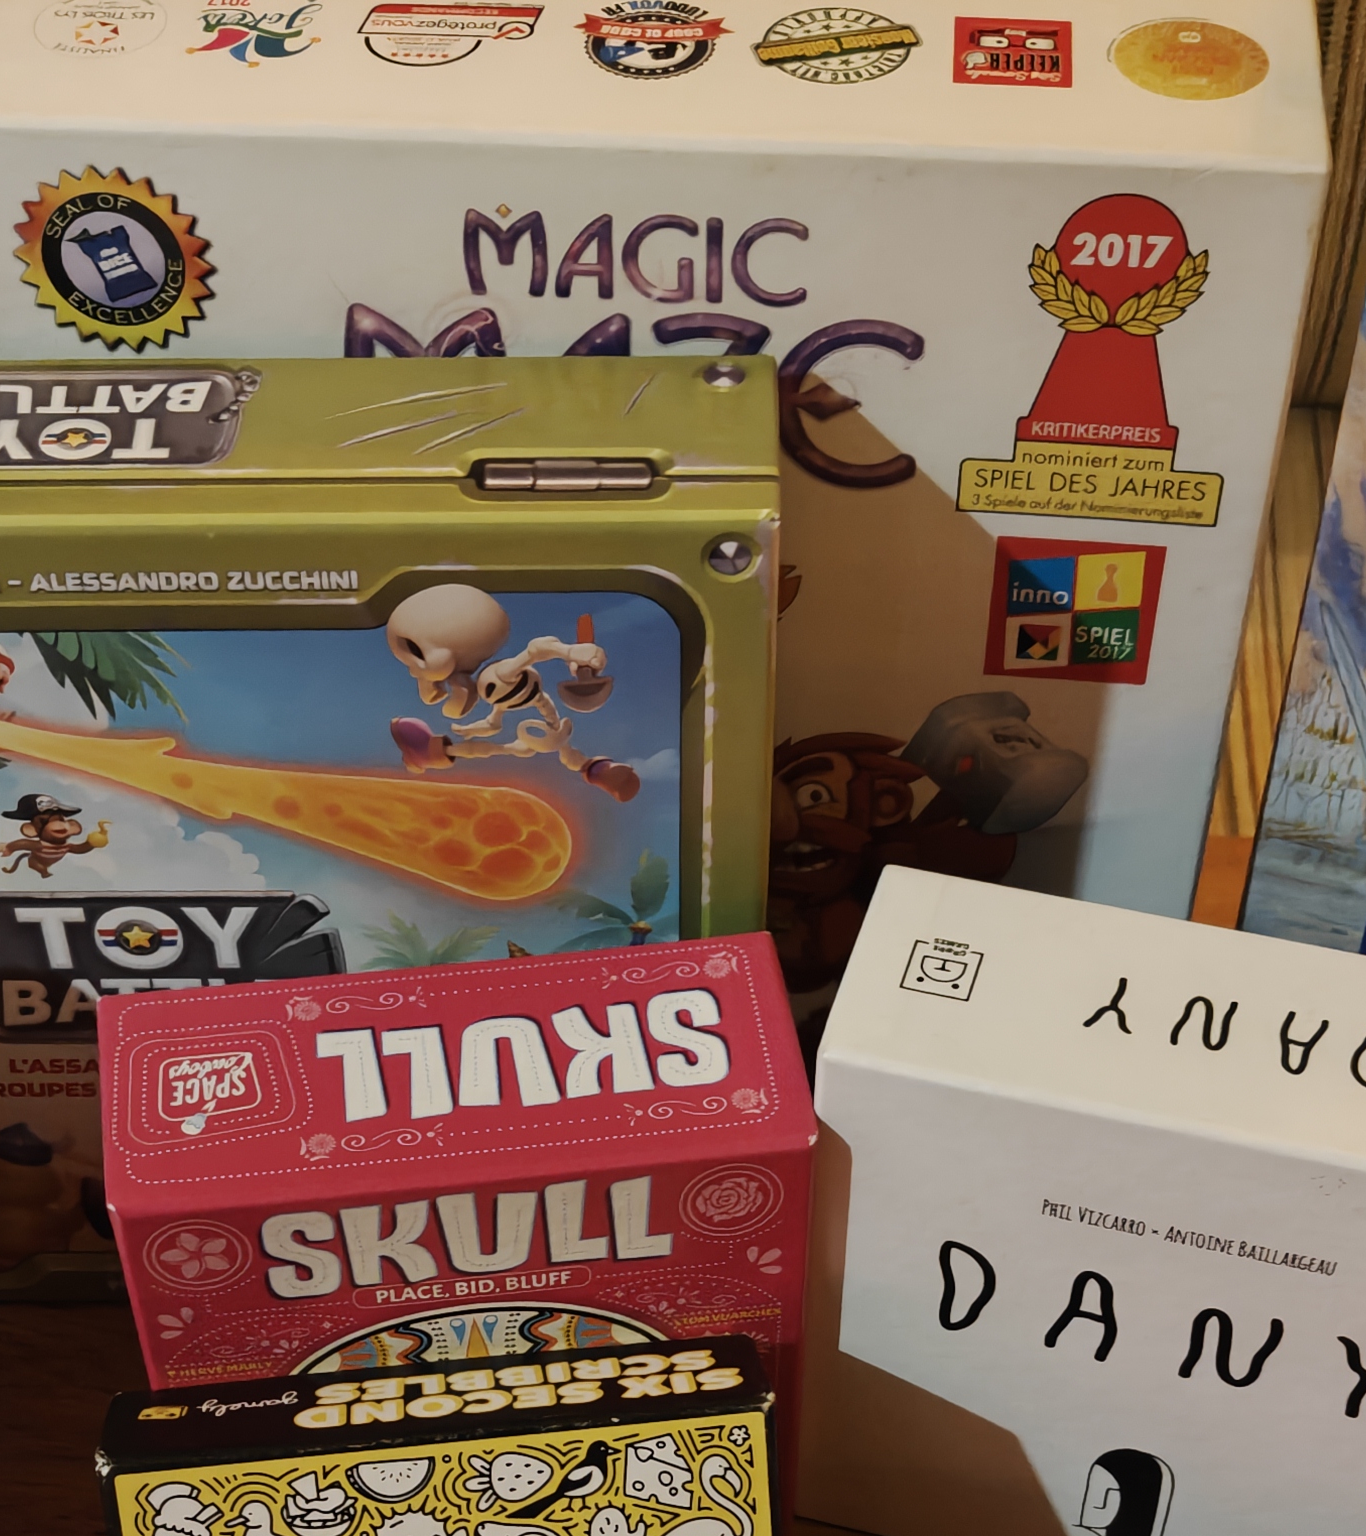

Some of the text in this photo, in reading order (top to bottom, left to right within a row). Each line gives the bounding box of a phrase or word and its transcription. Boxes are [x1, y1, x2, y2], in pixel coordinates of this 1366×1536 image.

[45, 193, 131, 238] SEAL OF
[463, 208, 809, 307] MAGIC
[1071, 232, 1174, 270] 2017
[67, 258, 183, 324] EXCELLENCE
[1031, 421, 1161, 443] KRITIKERPREIS
[1021, 450, 1165, 472] nominiert zum
[974, 468, 1207, 502] SPIEL DES JAHRES
[29, 572, 219, 593] ALESSANDRO
[226, 570, 358, 592] ZUCCHINI
[1012, 582, 1069, 605] inno
[1075, 626, 1134, 647] SPIEL
[1087, 645, 1134, 661] 2017
[14, 906, 258, 971] TOY
[315, 989, 731, 1124] SKULL
[170, 1065, 247, 1107] SPACE
[260, 1175, 675, 1300] SKULL
[1042, 1198, 1235, 1256] PHIL VIZCARRO ANTOINE
[504, 1269, 573, 1293] BLUFF
[315, 1349, 716, 1404] SCRIBBLES
[293, 1367, 744, 1429] SIX SECOND
